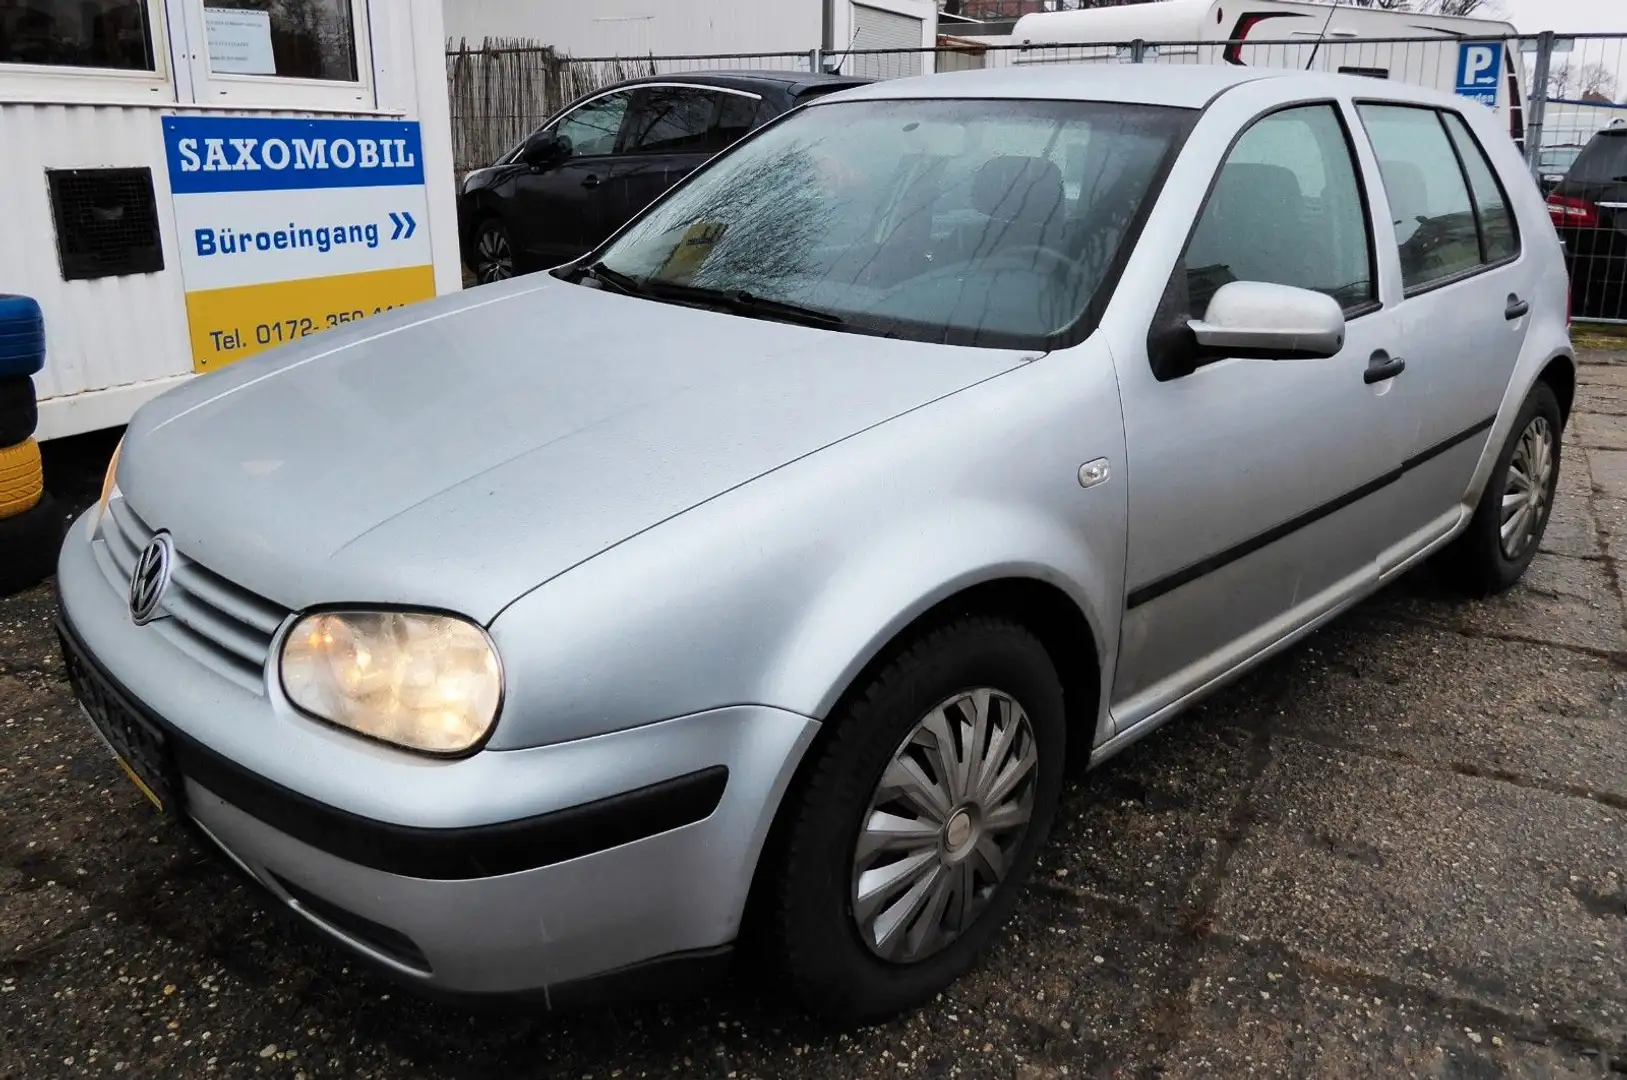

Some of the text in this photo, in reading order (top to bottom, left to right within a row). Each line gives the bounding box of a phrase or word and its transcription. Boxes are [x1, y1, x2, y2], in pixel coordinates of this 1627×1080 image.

[1463, 46, 1493, 85] P
[178, 138, 415, 172] SAXOMOBIL
[195, 223, 380, 256] Büroeingang
[210, 328, 247, 352] Tel.
